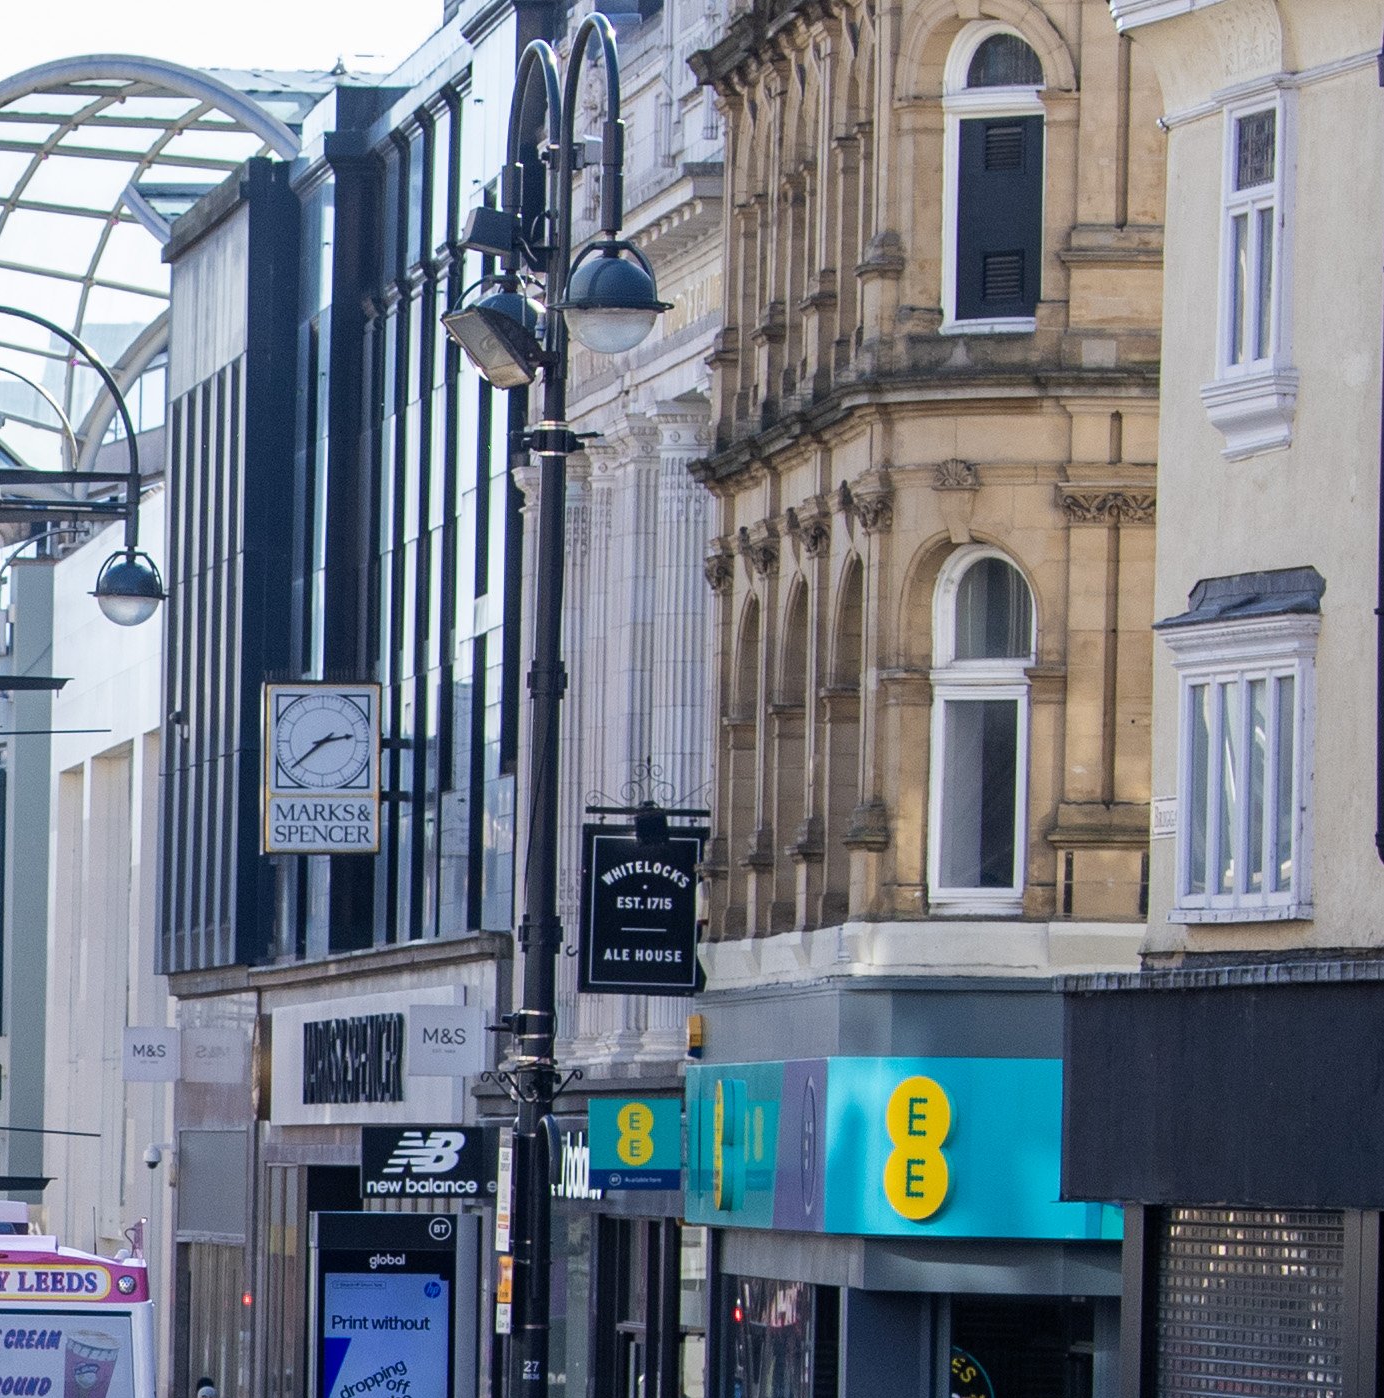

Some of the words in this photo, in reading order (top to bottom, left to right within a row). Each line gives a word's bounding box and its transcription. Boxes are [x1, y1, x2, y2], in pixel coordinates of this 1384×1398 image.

[275, 804, 354, 821] MARKS
[358, 804, 371, 821] &
[275, 825, 372, 844] SPENCER
[601, 860, 690, 888] WHITELOCK'S
[616, 897, 644, 909] EST.
[647, 898, 672, 910] 1715
[604, 948, 630, 961] ALE
[635, 949, 682, 962] HOUSE
[423, 1028, 466, 1044] M&S
[133, 1045, 166, 1058] M&S
[366, 1180, 402, 1193] new
[406, 1178, 477, 1194] balance
[432, 1224, 447, 1233] BT
[369, 1254, 406, 1269] global
[18, 1271, 98, 1293] LEEDS
[331, 1315, 369, 1330] Print
[372, 1316, 431, 1331] without
[3, 1329, 62, 1350] CREAM
[523, 1361, 540, 1373] 27
[386, 1378, 411, 1394] off
